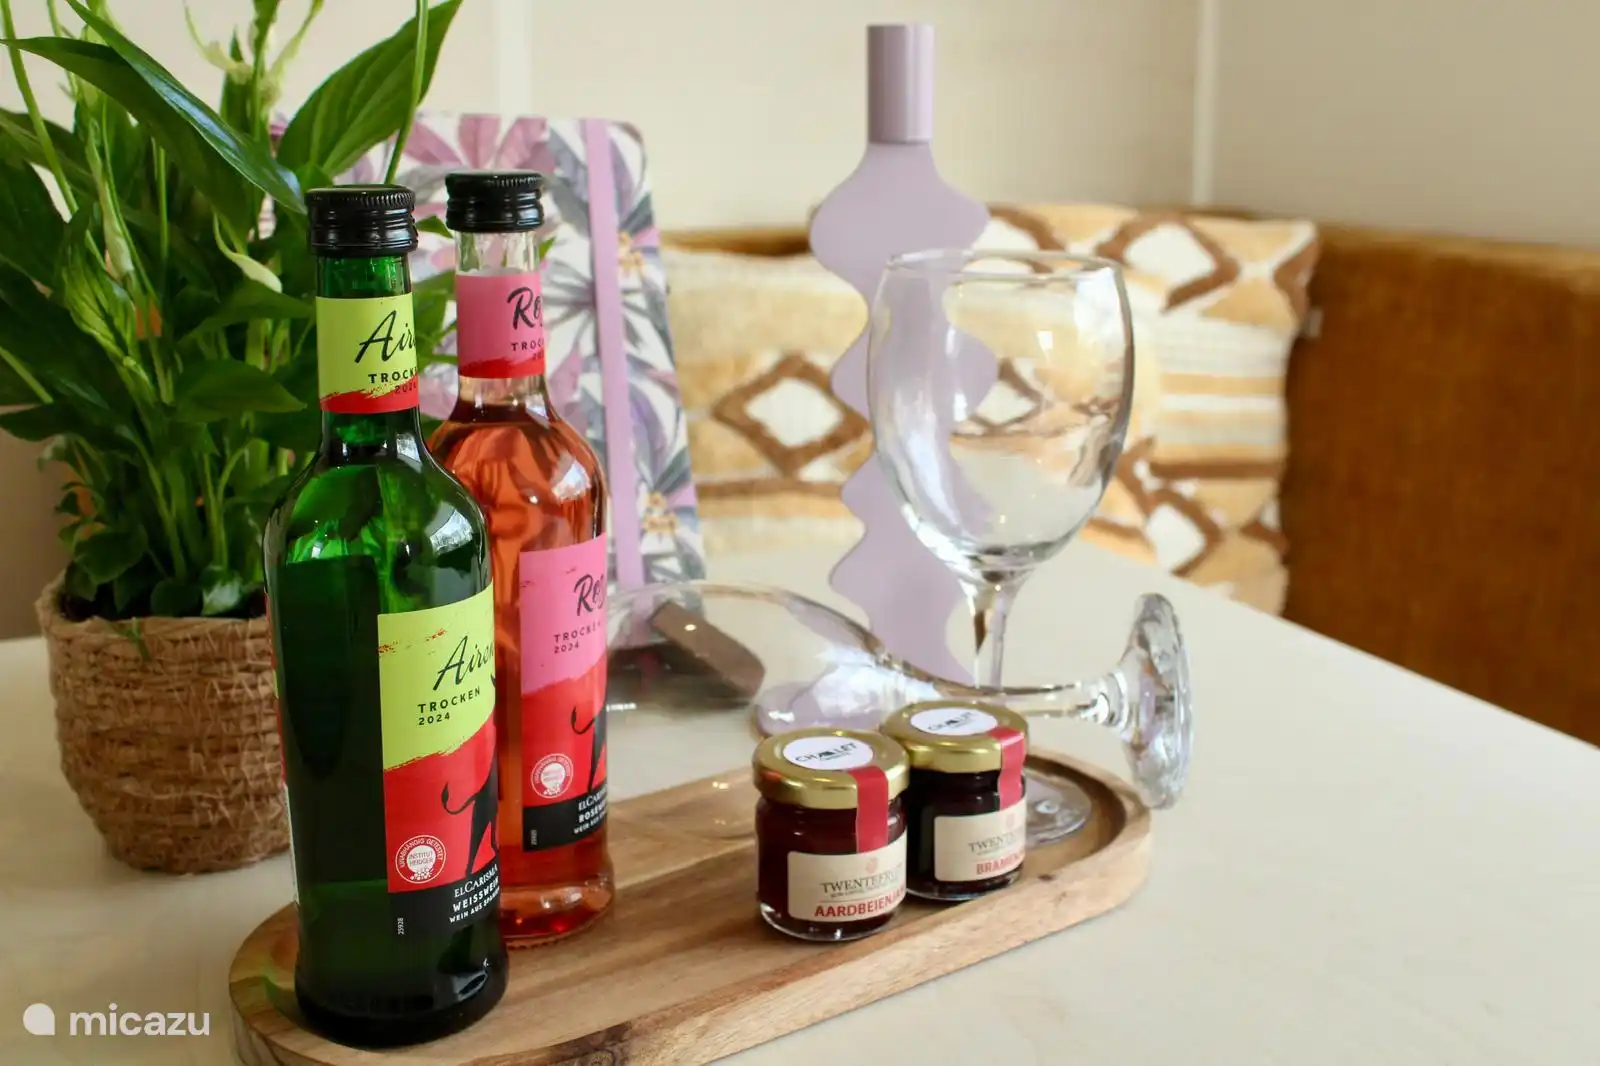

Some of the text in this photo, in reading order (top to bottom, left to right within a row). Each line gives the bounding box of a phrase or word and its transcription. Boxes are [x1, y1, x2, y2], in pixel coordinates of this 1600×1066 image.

[417, 686, 481, 714] TROCKEN
[418, 712, 451, 726] 2024
[449, 911, 469, 924] WEIN
[470, 902, 482, 915] AUS
